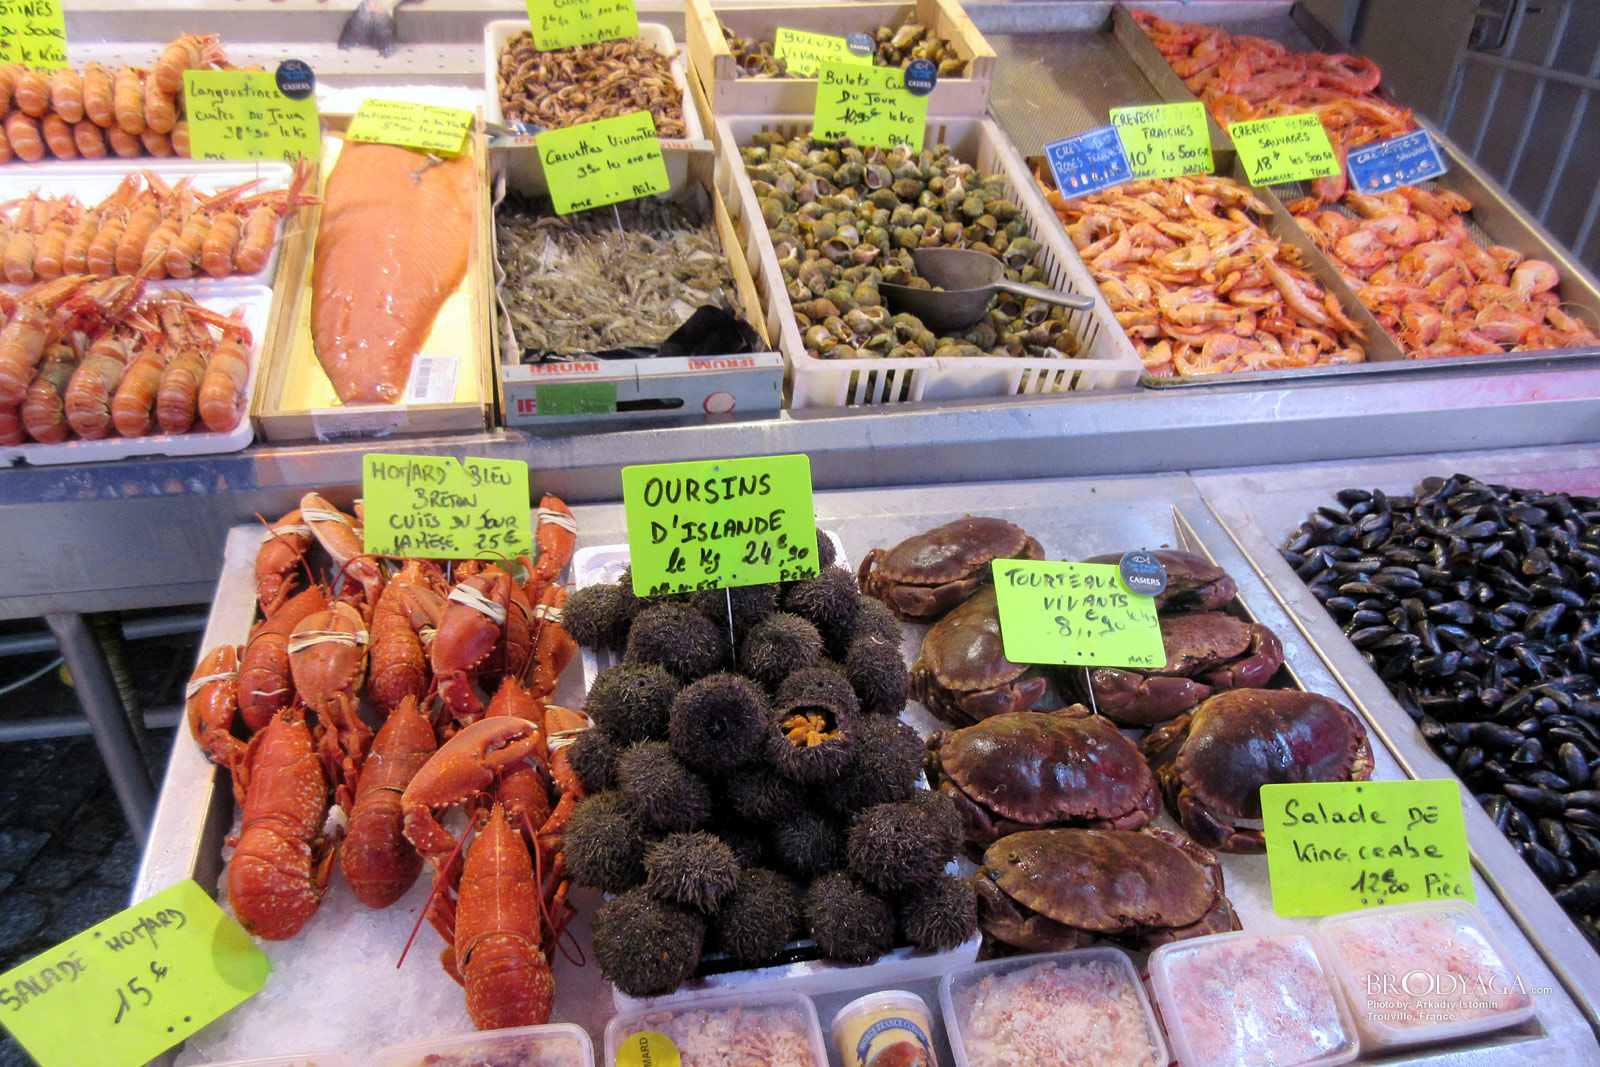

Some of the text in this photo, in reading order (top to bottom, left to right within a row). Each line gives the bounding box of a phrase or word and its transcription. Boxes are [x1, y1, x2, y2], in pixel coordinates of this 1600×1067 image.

[644, 474, 771, 507] OURSINS
[651, 509, 786, 545] D'ISLANDE
[665, 547, 687, 574] le
[1129, 575, 1161, 586] CASIERS
[1282, 798, 1387, 827] Salade
